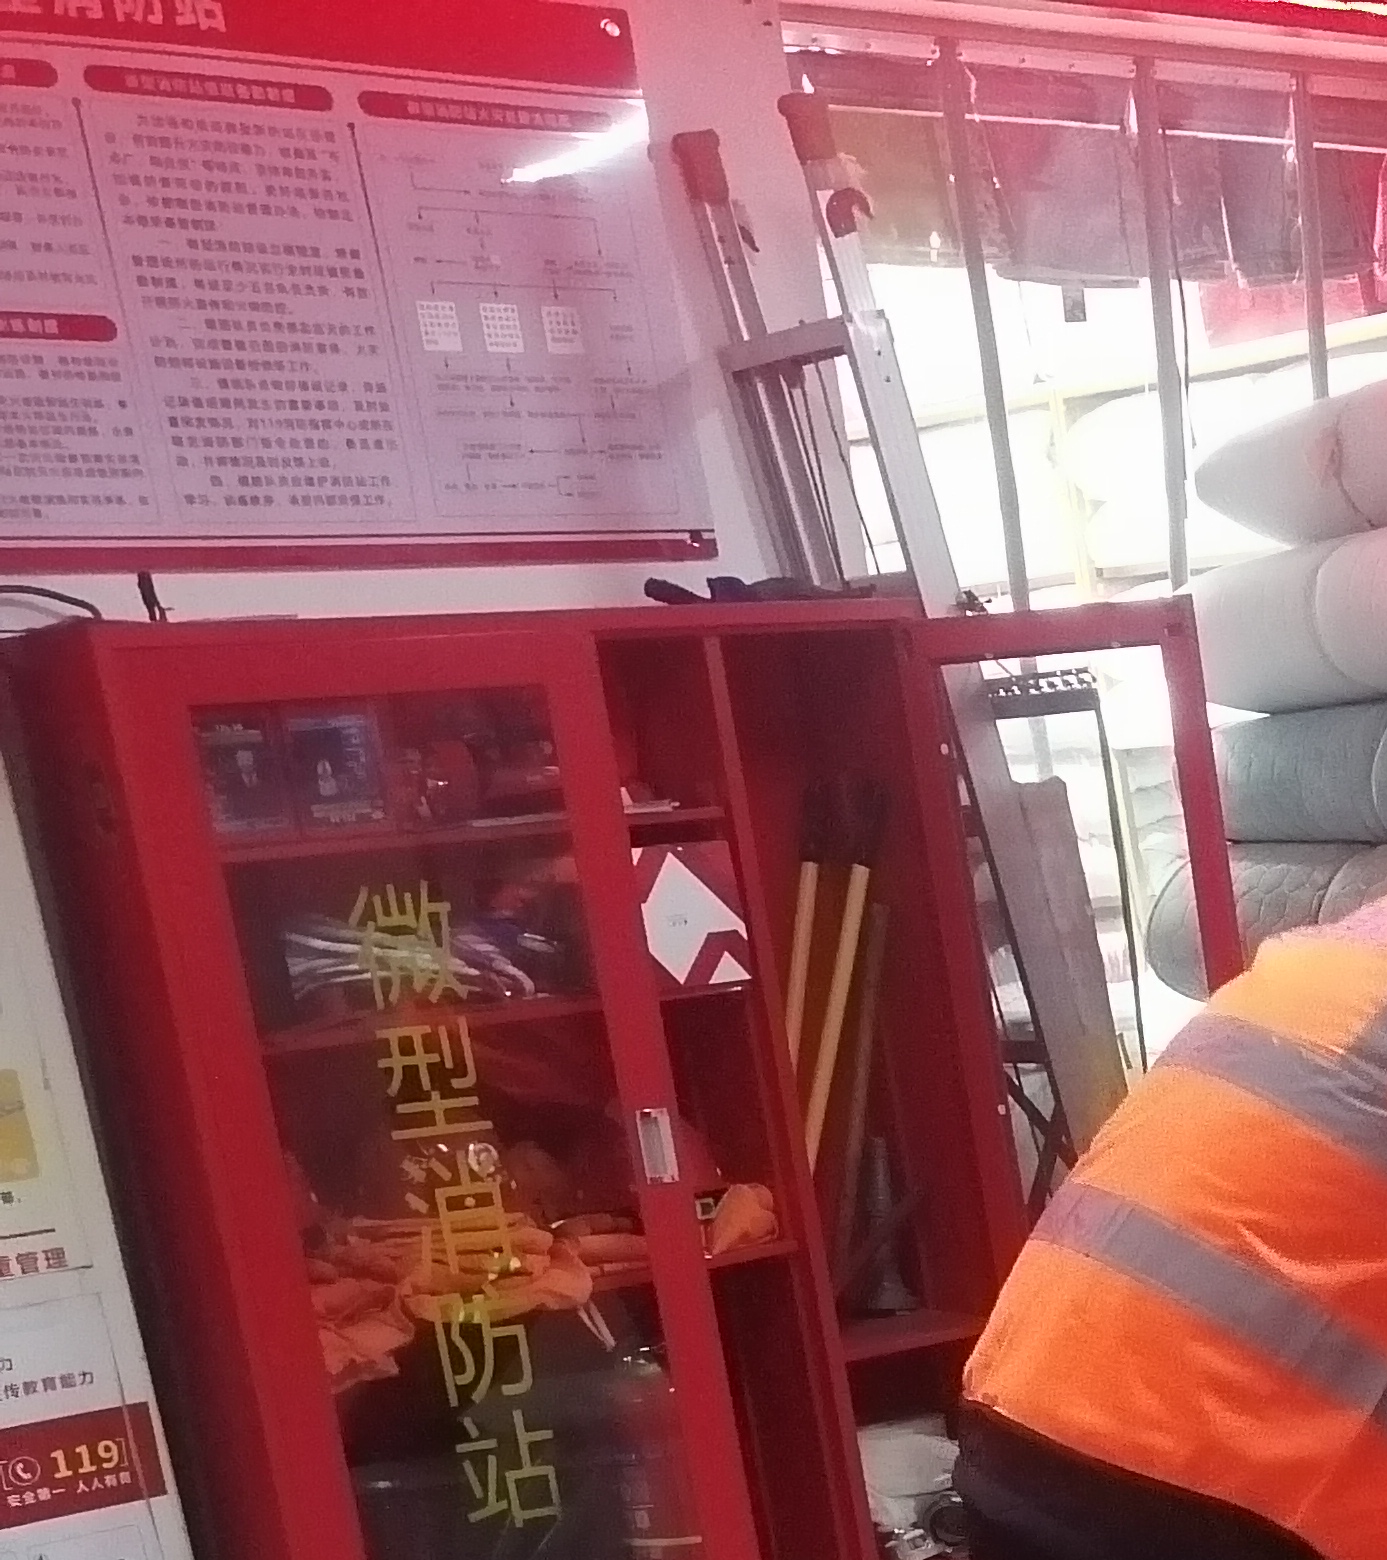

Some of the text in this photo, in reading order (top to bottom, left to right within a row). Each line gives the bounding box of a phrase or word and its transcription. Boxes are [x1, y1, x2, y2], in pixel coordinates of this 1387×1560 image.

[349, 880, 561, 1528] 微型消防站
[50, 1440, 120, 1479] 119
